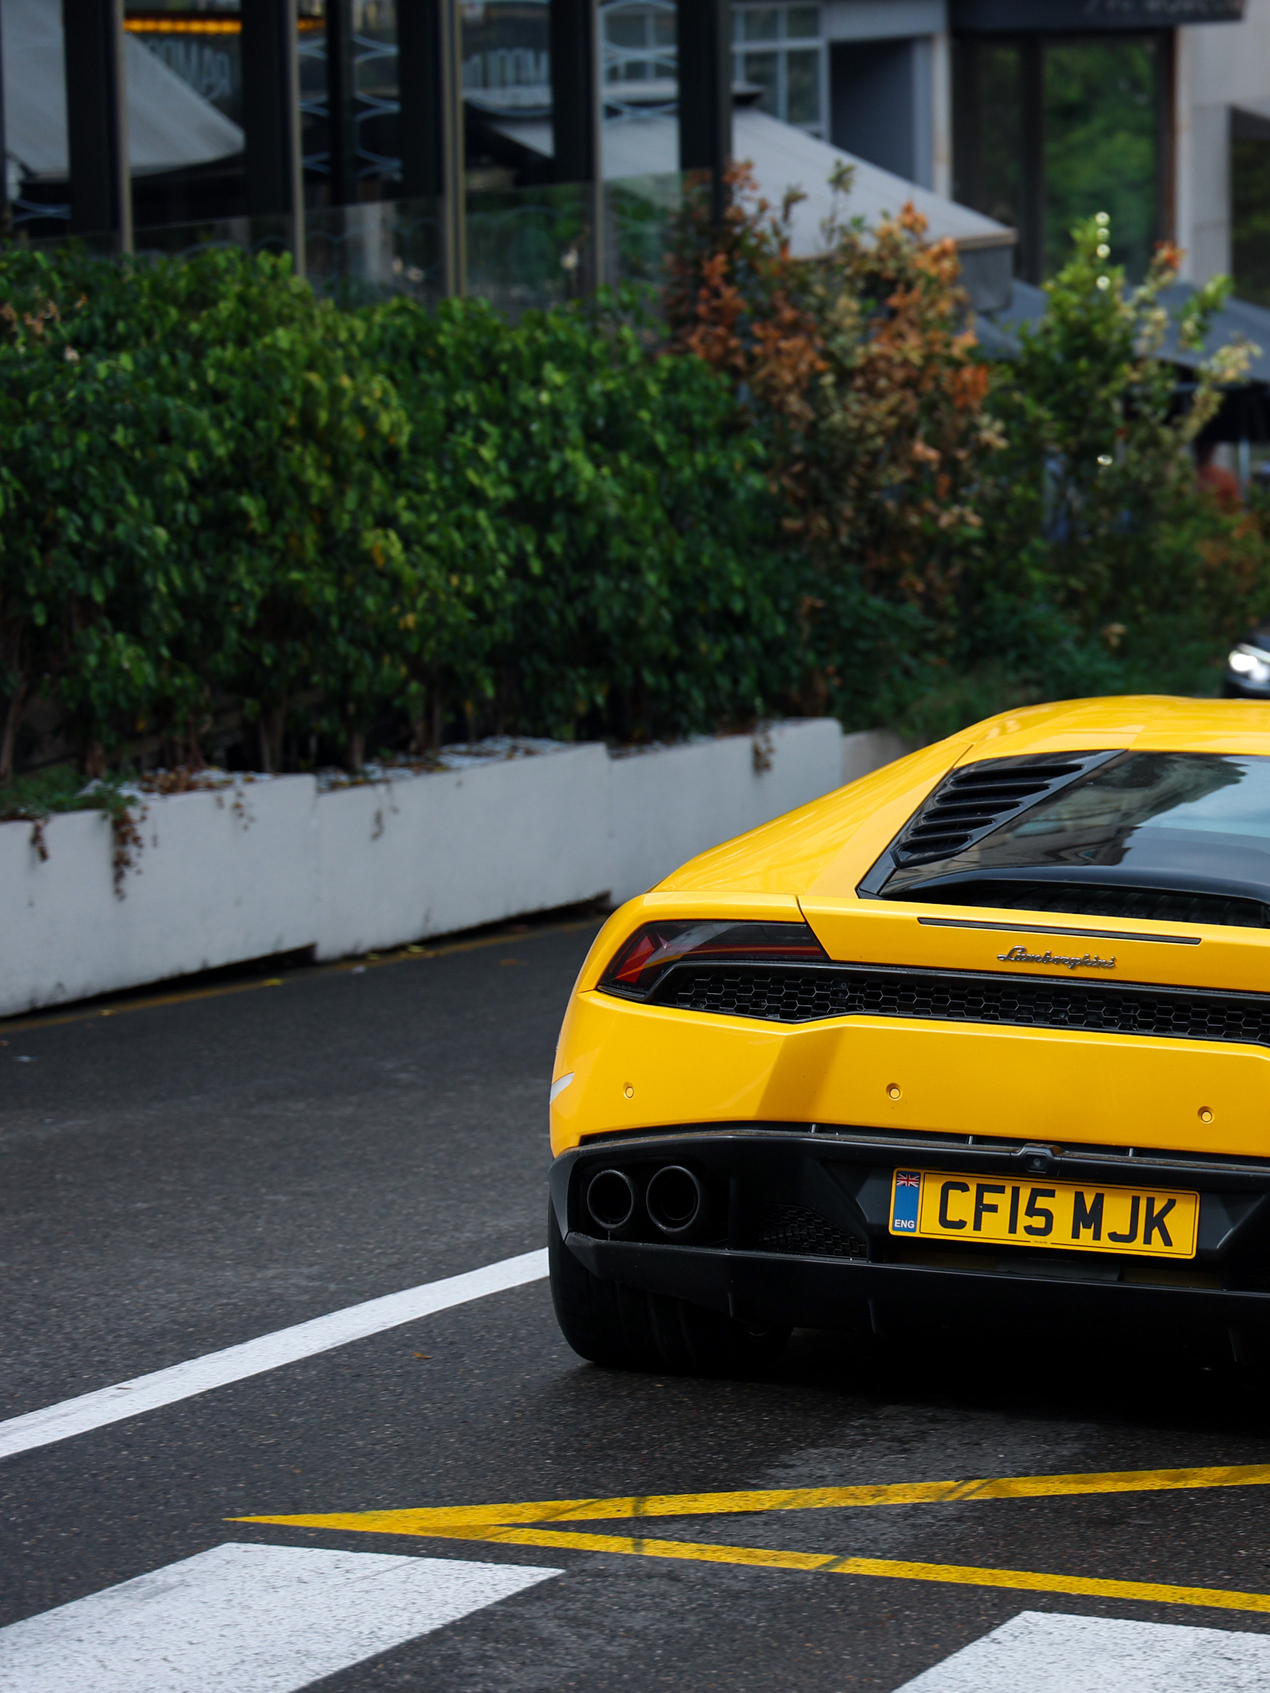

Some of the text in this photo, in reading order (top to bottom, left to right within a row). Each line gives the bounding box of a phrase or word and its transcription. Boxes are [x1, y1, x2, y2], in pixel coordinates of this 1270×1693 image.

[997, 945, 1116, 969] Lamborghini
[894, 1219, 915, 1230] ENG
[938, 1181, 1177, 1247] CF15 MJK
